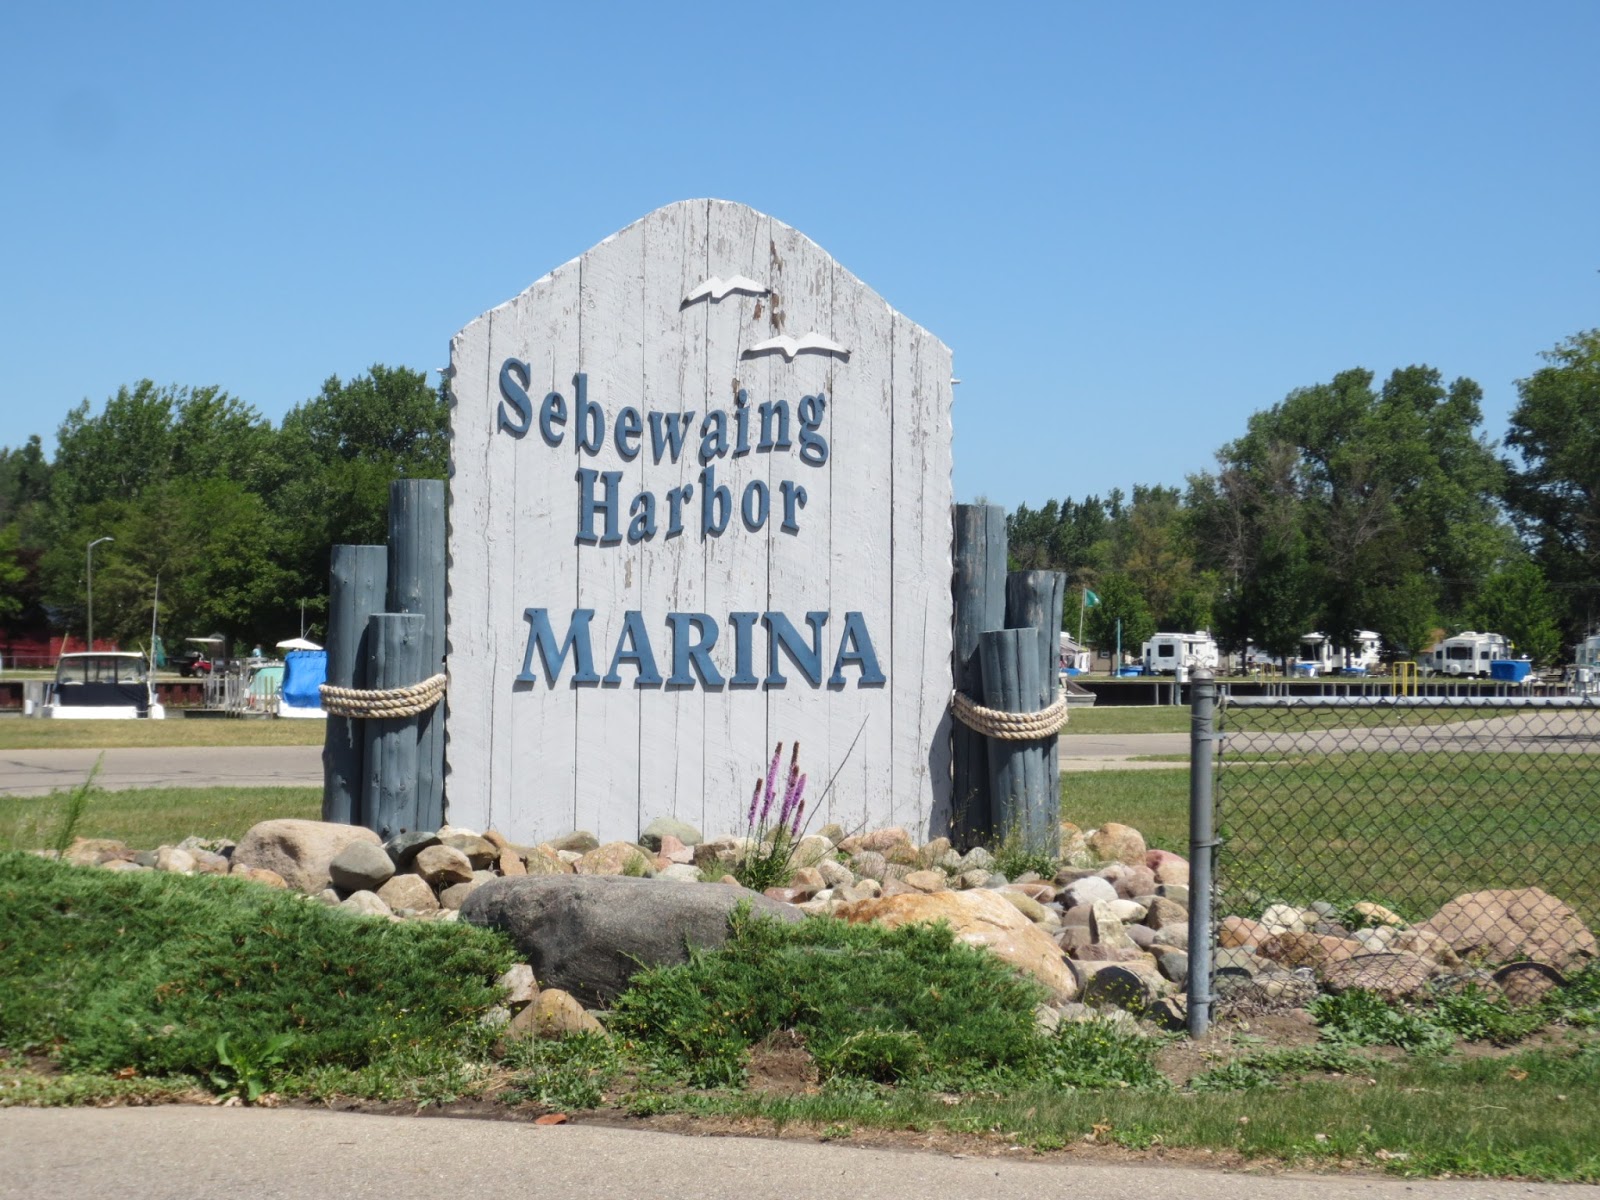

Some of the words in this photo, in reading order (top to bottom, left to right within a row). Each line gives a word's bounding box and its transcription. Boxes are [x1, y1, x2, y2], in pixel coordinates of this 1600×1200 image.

[498, 357, 829, 466] Sebewaing
[576, 465, 807, 545] Harbor
[515, 608, 887, 688] MARINA
